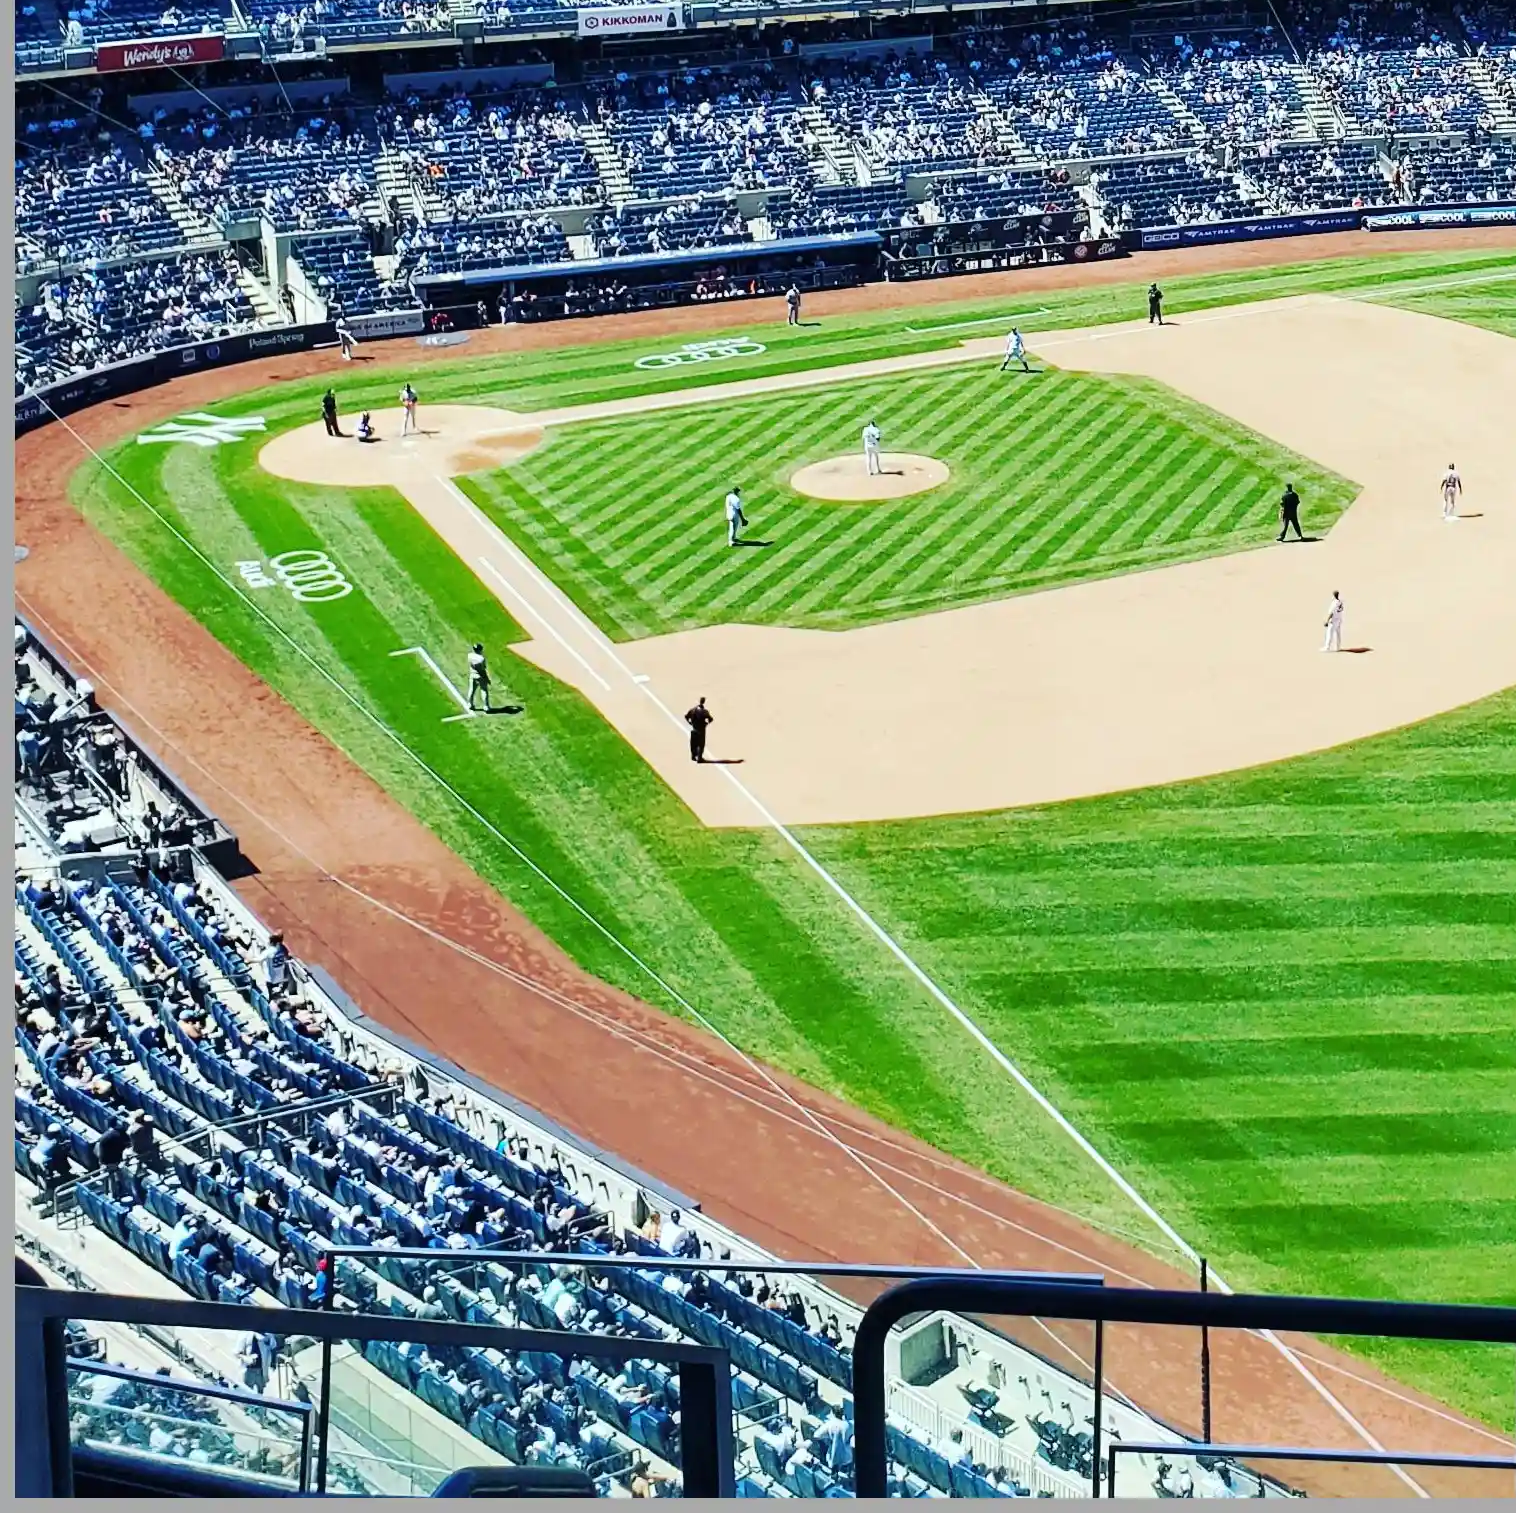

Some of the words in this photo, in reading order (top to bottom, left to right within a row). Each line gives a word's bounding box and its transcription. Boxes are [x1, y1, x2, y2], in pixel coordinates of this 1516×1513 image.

[602, 13, 663, 27] KIKKOMAN
[123, 46, 172, 67] Wendy's
[1316, 217, 1354, 227] AMTRAK
[1388, 214, 1415, 225] COOL
[1440, 212, 1467, 223] COOL
[1198, 228, 1237, 238] AMTRAK
[1255, 223, 1295, 232] AMTRAK
[1144, 231, 1180, 244] GEICO
